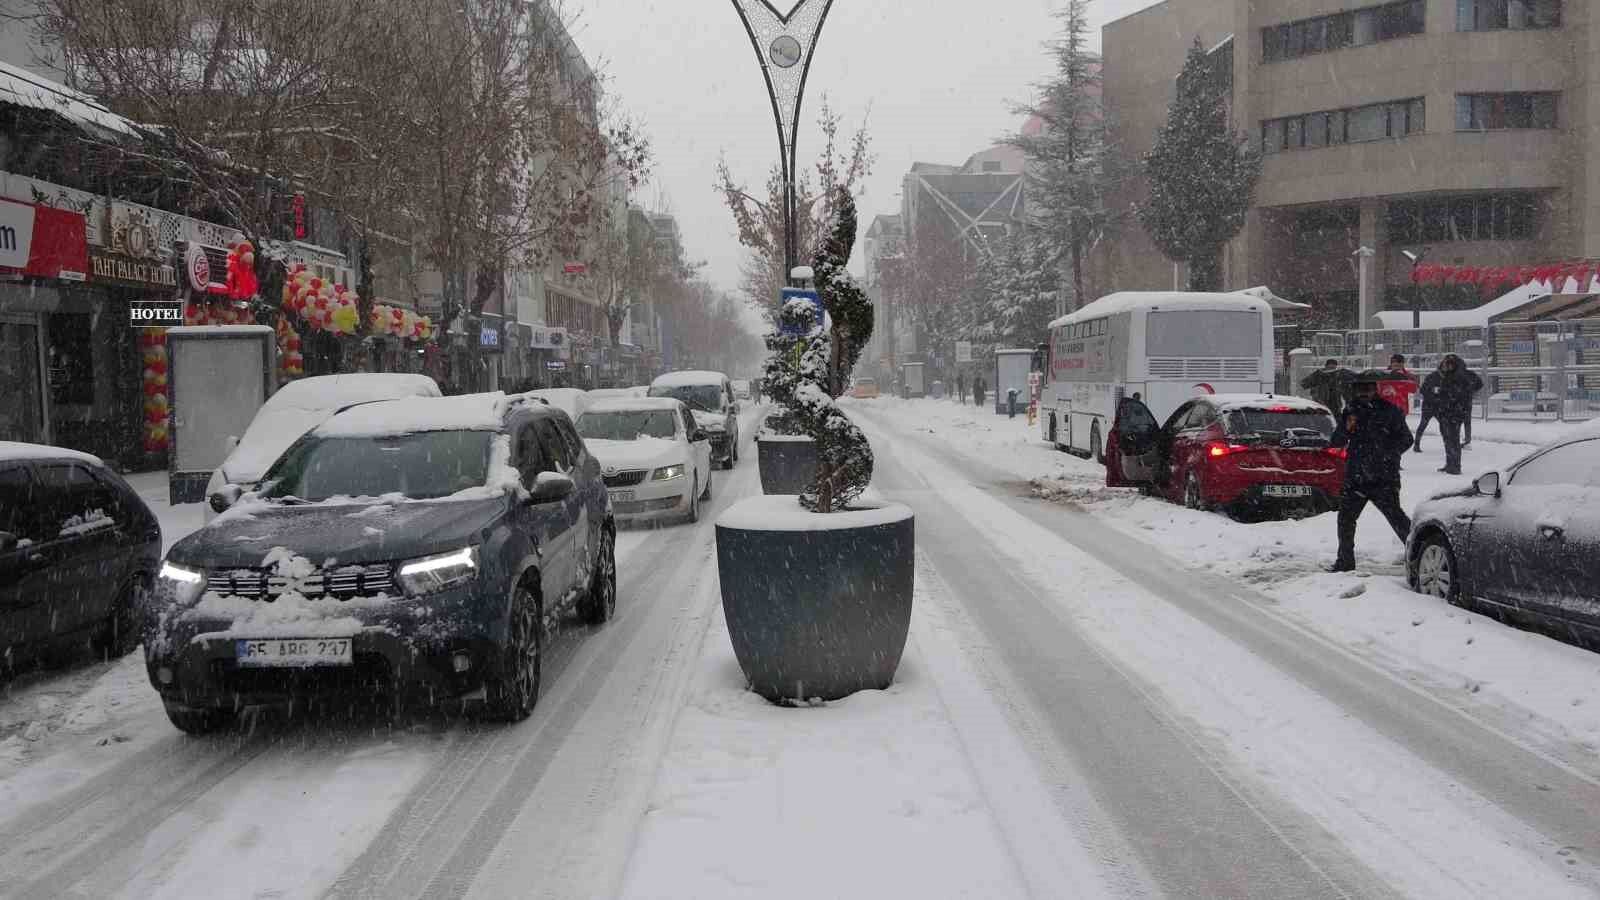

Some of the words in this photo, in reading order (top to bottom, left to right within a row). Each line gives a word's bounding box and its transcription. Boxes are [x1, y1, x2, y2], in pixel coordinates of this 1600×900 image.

[93, 256, 115, 277] TAHT
[118, 261, 146, 281] PALACE
[151, 267, 176, 286] HOTEL
[131, 308, 183, 320] HOTEL
